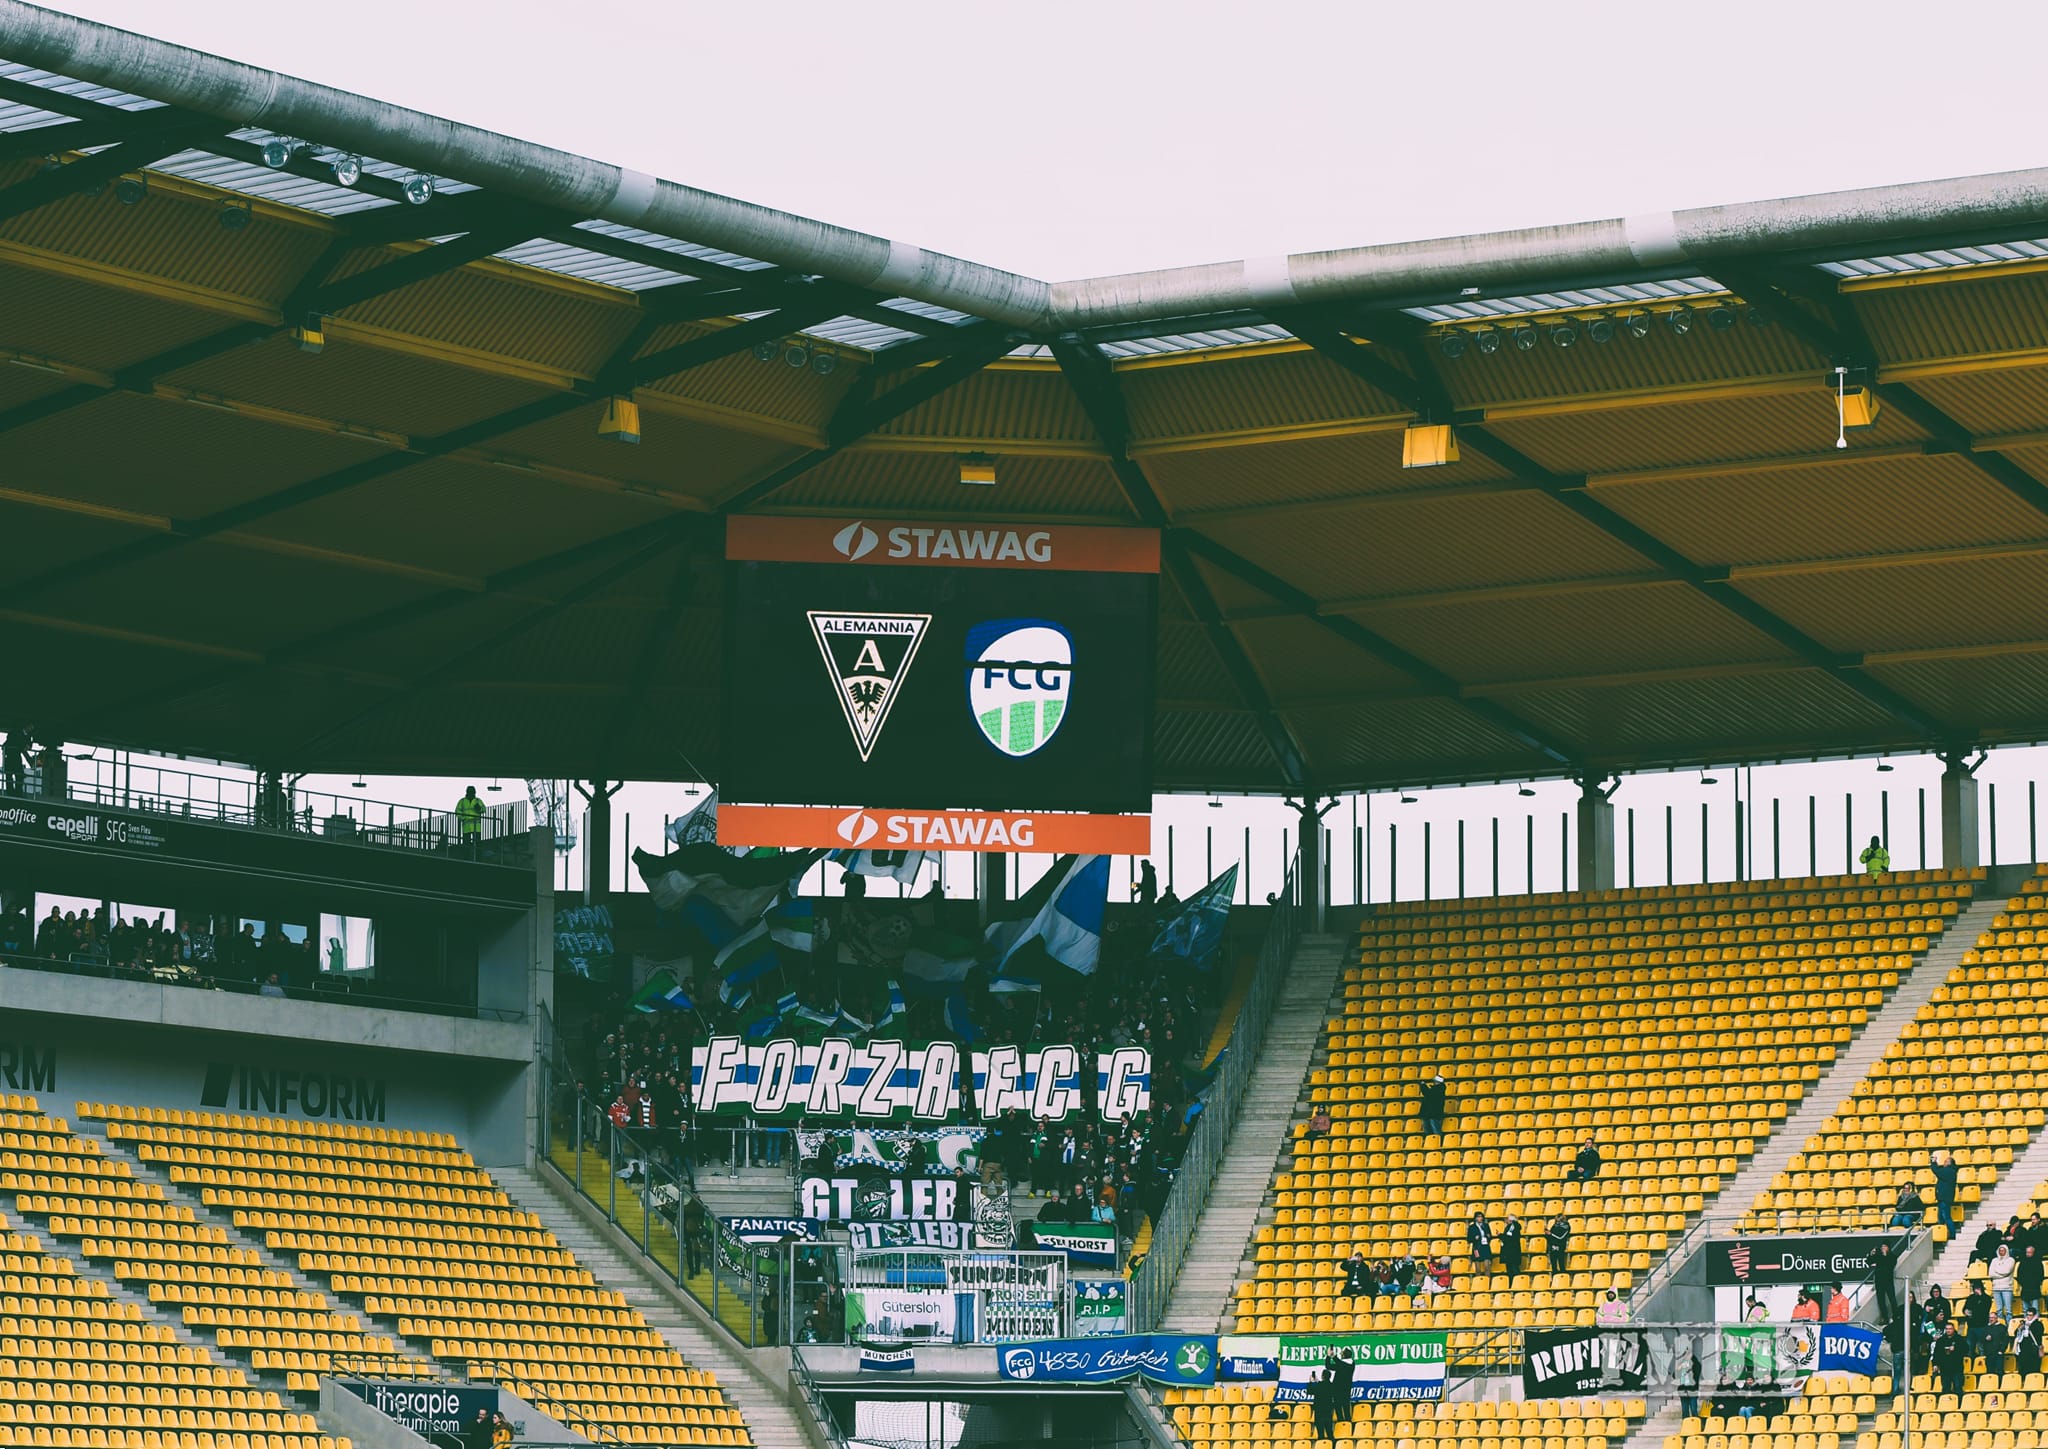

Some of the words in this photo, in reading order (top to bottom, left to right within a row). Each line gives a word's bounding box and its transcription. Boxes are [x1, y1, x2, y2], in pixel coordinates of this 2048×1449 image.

[888, 527, 1052, 562] STAWAG
[823, 620, 915, 634] ALEMANNIA
[853, 639, 886, 672] A
[984, 660, 1061, 690] FCG
[47, 815, 98, 837] capelli
[106, 820, 126, 843] SFG
[887, 815, 1034, 846] STAWAG
[70, 833, 98, 842] SPORT
[697, 1035, 958, 1120] FORZA
[982, 1043, 1148, 1123] FCG
[239, 1060, 386, 1123] INFORM
[801, 1177, 858, 1221] GT
[731, 1218, 808, 1234] FANATICS
[848, 1222, 882, 1249] GT
[910, 1222, 974, 1250] LEBT
[1781, 1253, 1826, 1271] DÖNER
[1831, 1254, 1869, 1274] CENTER
[882, 1301, 941, 1314] Gütersloh
[985, 1317, 1056, 1337] MINDEN
[1374, 1343, 1397, 1360] ON
[1400, 1342, 1444, 1360] TOUR
[1823, 1336, 1873, 1360] BOYS
[1010, 1358, 1032, 1368] FCG
[1038, 1350, 1092, 1371] 4830
[1233, 1357, 1265, 1375] Münden
[375, 1385, 460, 1418] therapie
[1367, 1385, 1442, 1401] GÜTERSLOH
